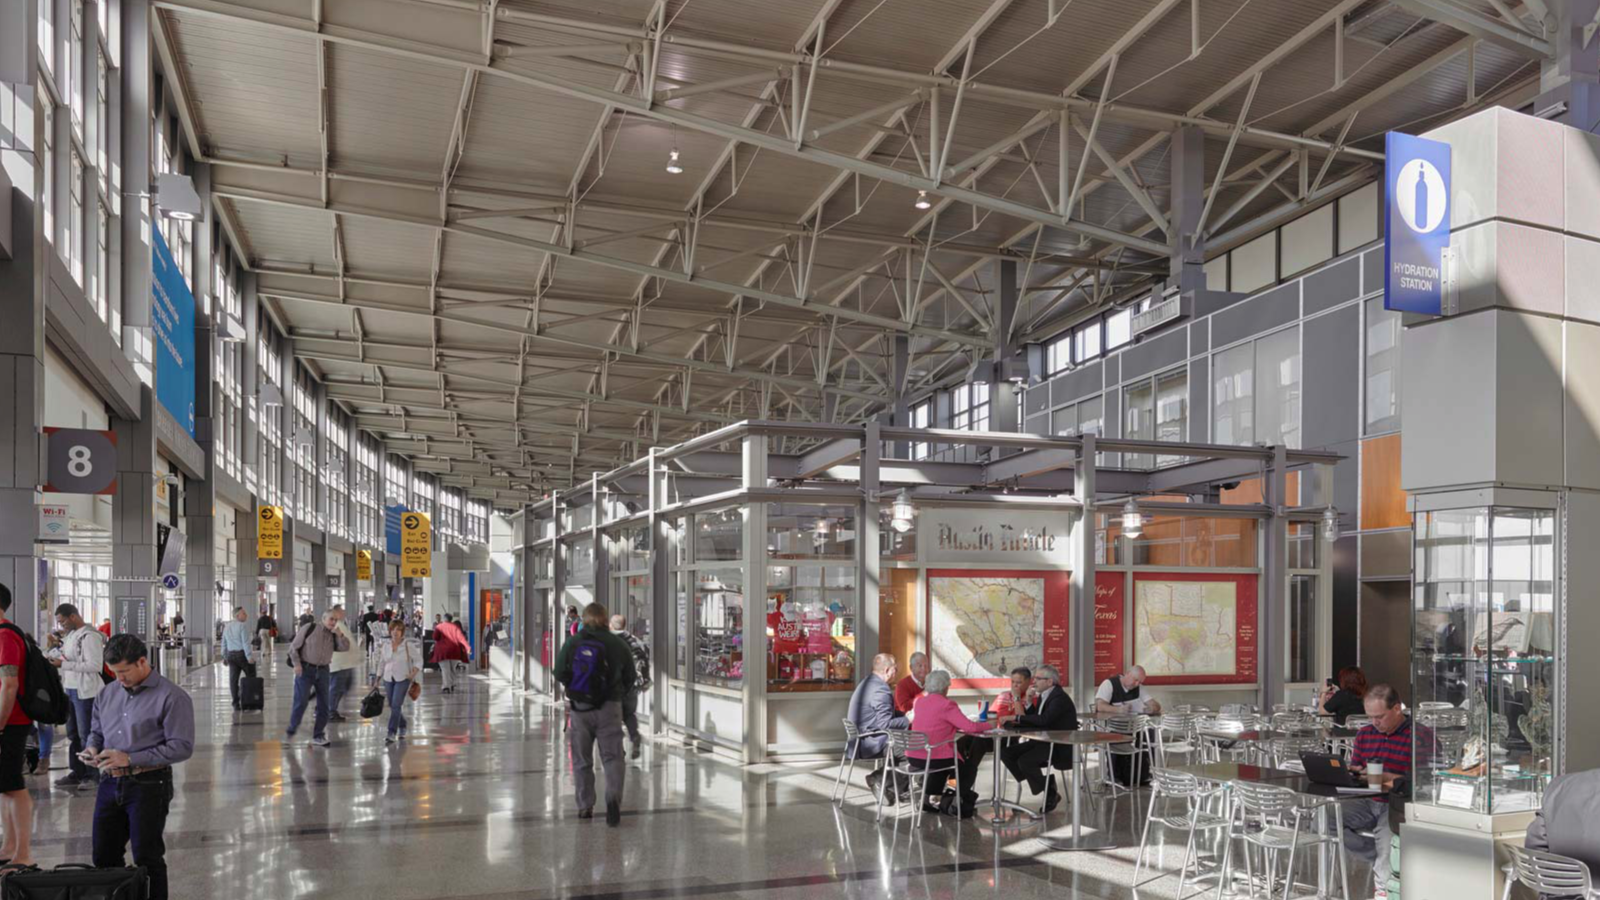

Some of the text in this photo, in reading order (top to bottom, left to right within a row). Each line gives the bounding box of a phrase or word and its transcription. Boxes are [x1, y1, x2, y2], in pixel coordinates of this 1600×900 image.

[1393, 262, 1439, 279] HYDRATION
[1400, 276, 1433, 291] STATION
[67, 445, 93, 477] 8
[264, 562, 273, 573] 9
[329, 577, 339, 585] 10
[1094, 604, 1118, 620] Texas
